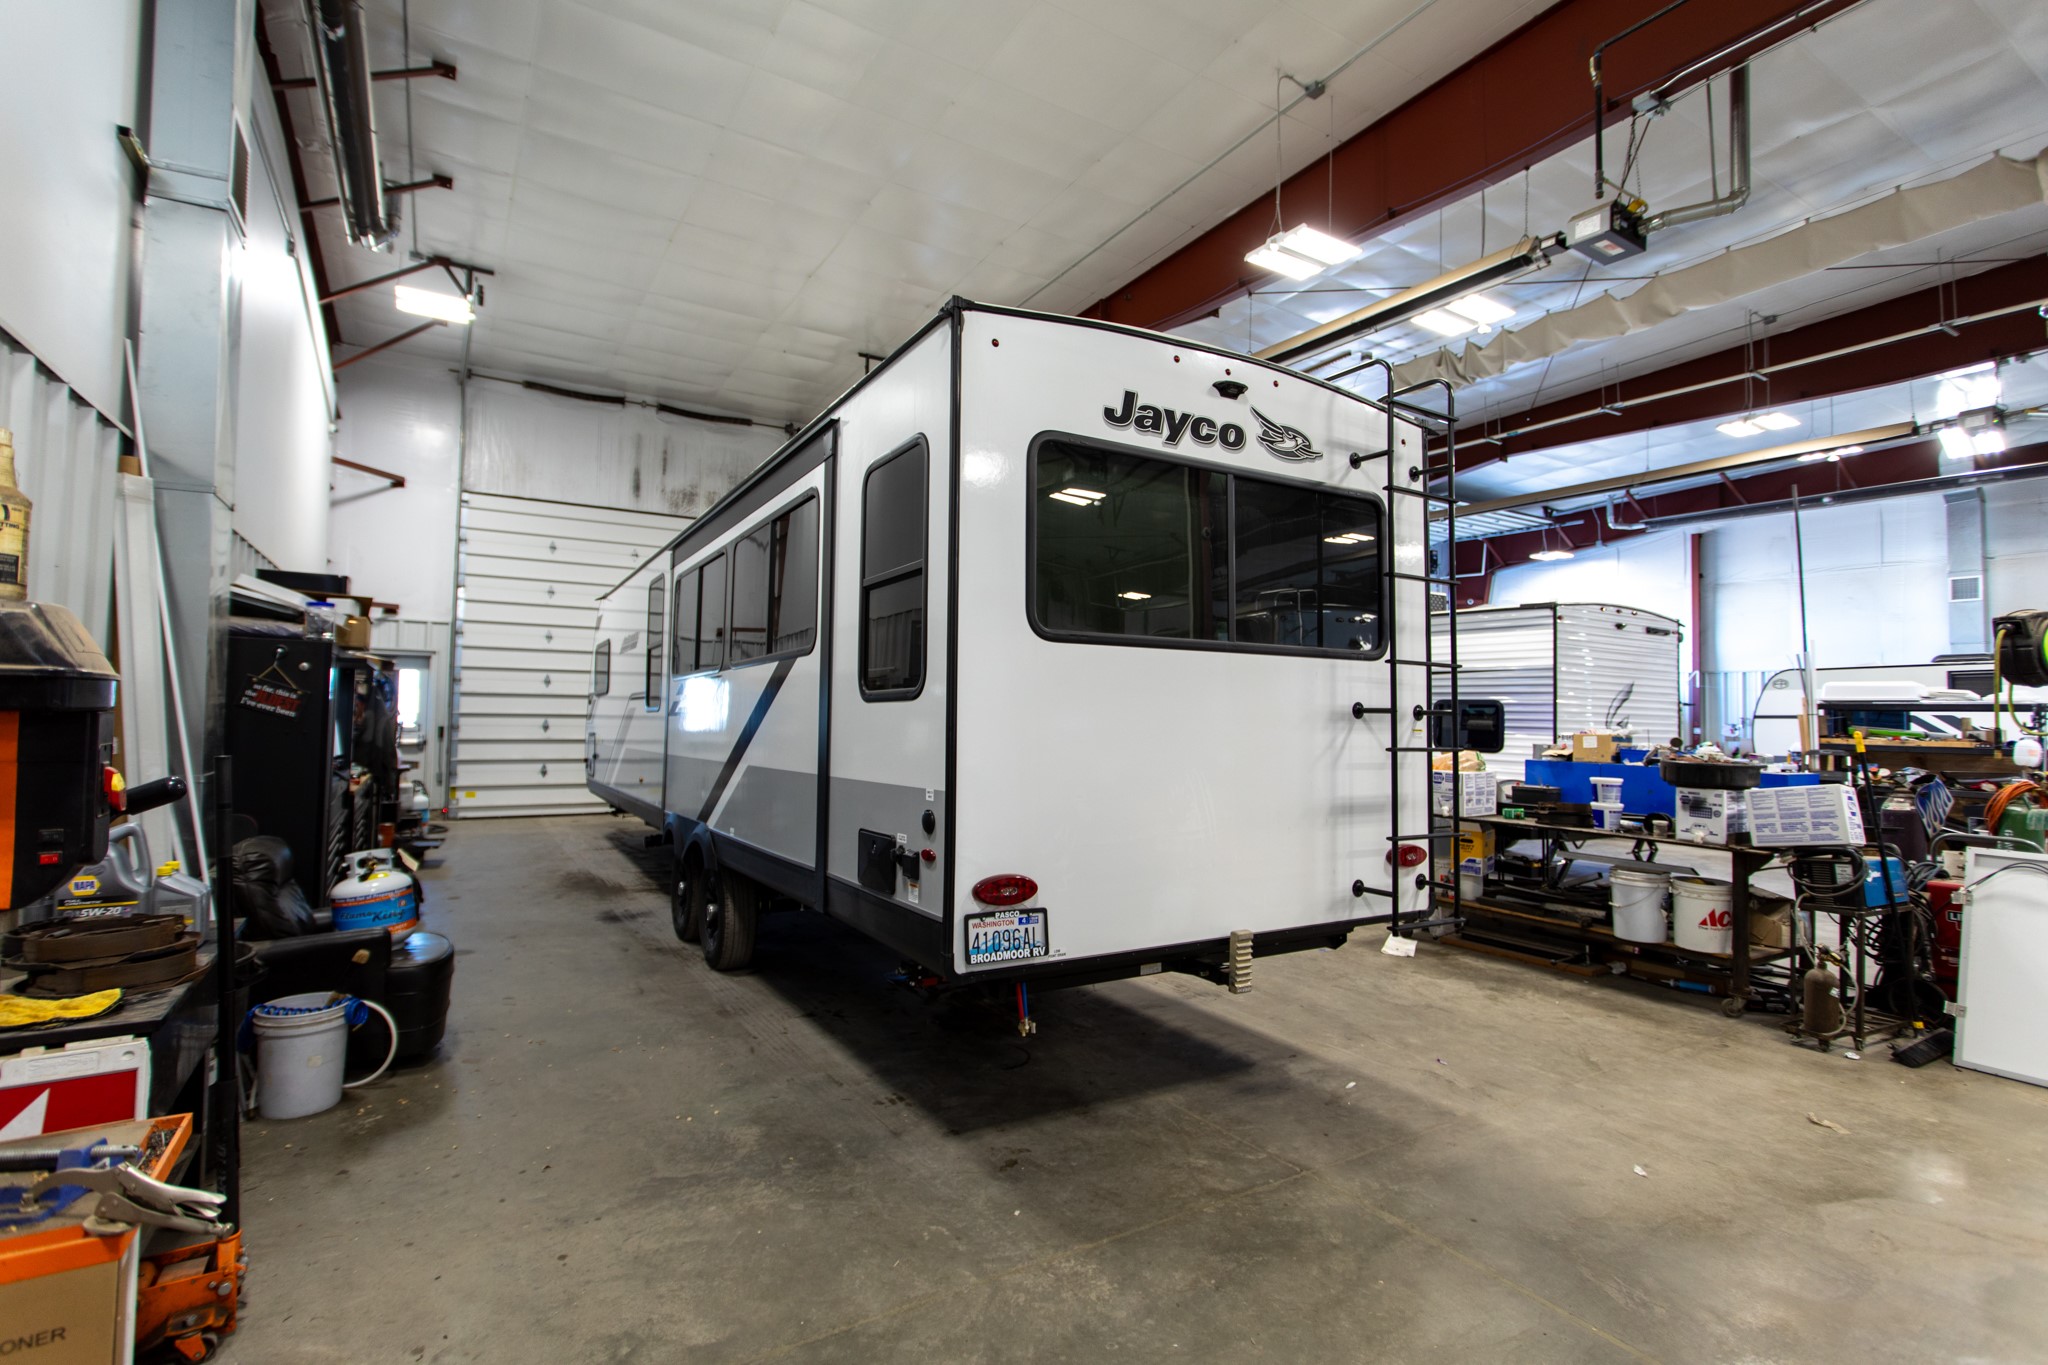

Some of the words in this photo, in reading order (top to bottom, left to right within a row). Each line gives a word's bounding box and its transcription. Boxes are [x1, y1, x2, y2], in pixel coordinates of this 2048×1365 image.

[1103, 388, 1246, 451] Jayco
[74, 881, 95, 890] NAPA
[80, 906, 122, 917] 5W-20
[995, 911, 1020, 919] PASCO
[1698, 908, 1733, 927] AC
[972, 919, 1015, 929] WASHINGTON
[972, 927, 1040, 954] 41096AL
[970, 949, 1031, 964] BROADMOOR
[1032, 946, 1046, 957] RV
[0, 1327, 66, 1356] ONER
